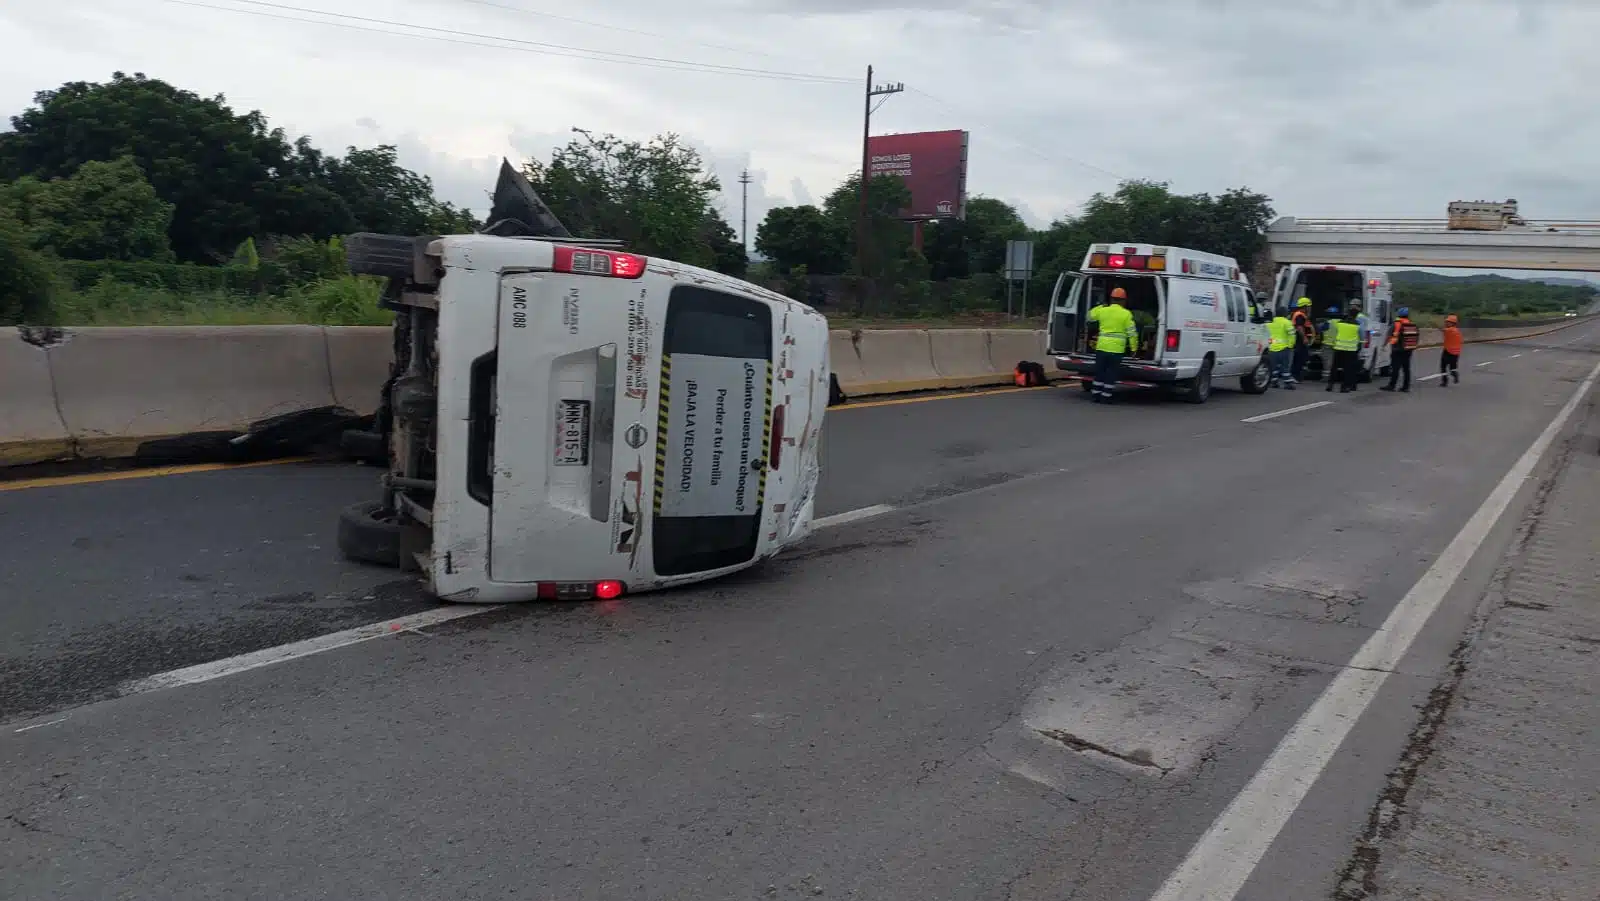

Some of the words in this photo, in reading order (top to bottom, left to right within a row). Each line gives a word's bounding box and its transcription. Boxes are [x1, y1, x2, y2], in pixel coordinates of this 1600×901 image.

[512, 286, 527, 310] AMC
[512, 312, 527, 328] 088
[634, 338, 645, 388] SUGENCIAS
[685, 380, 697, 412] ¡BAJA
[743, 362, 755, 409] ¿Cuánto
[685, 414, 696, 427] LA
[715, 389, 727, 426] Perder
[713, 436, 723, 448] tu
[741, 411, 751, 448] cuesta
[711, 450, 723, 486] familia
[740, 450, 749, 464] un
[735, 466, 749, 512] choque?
